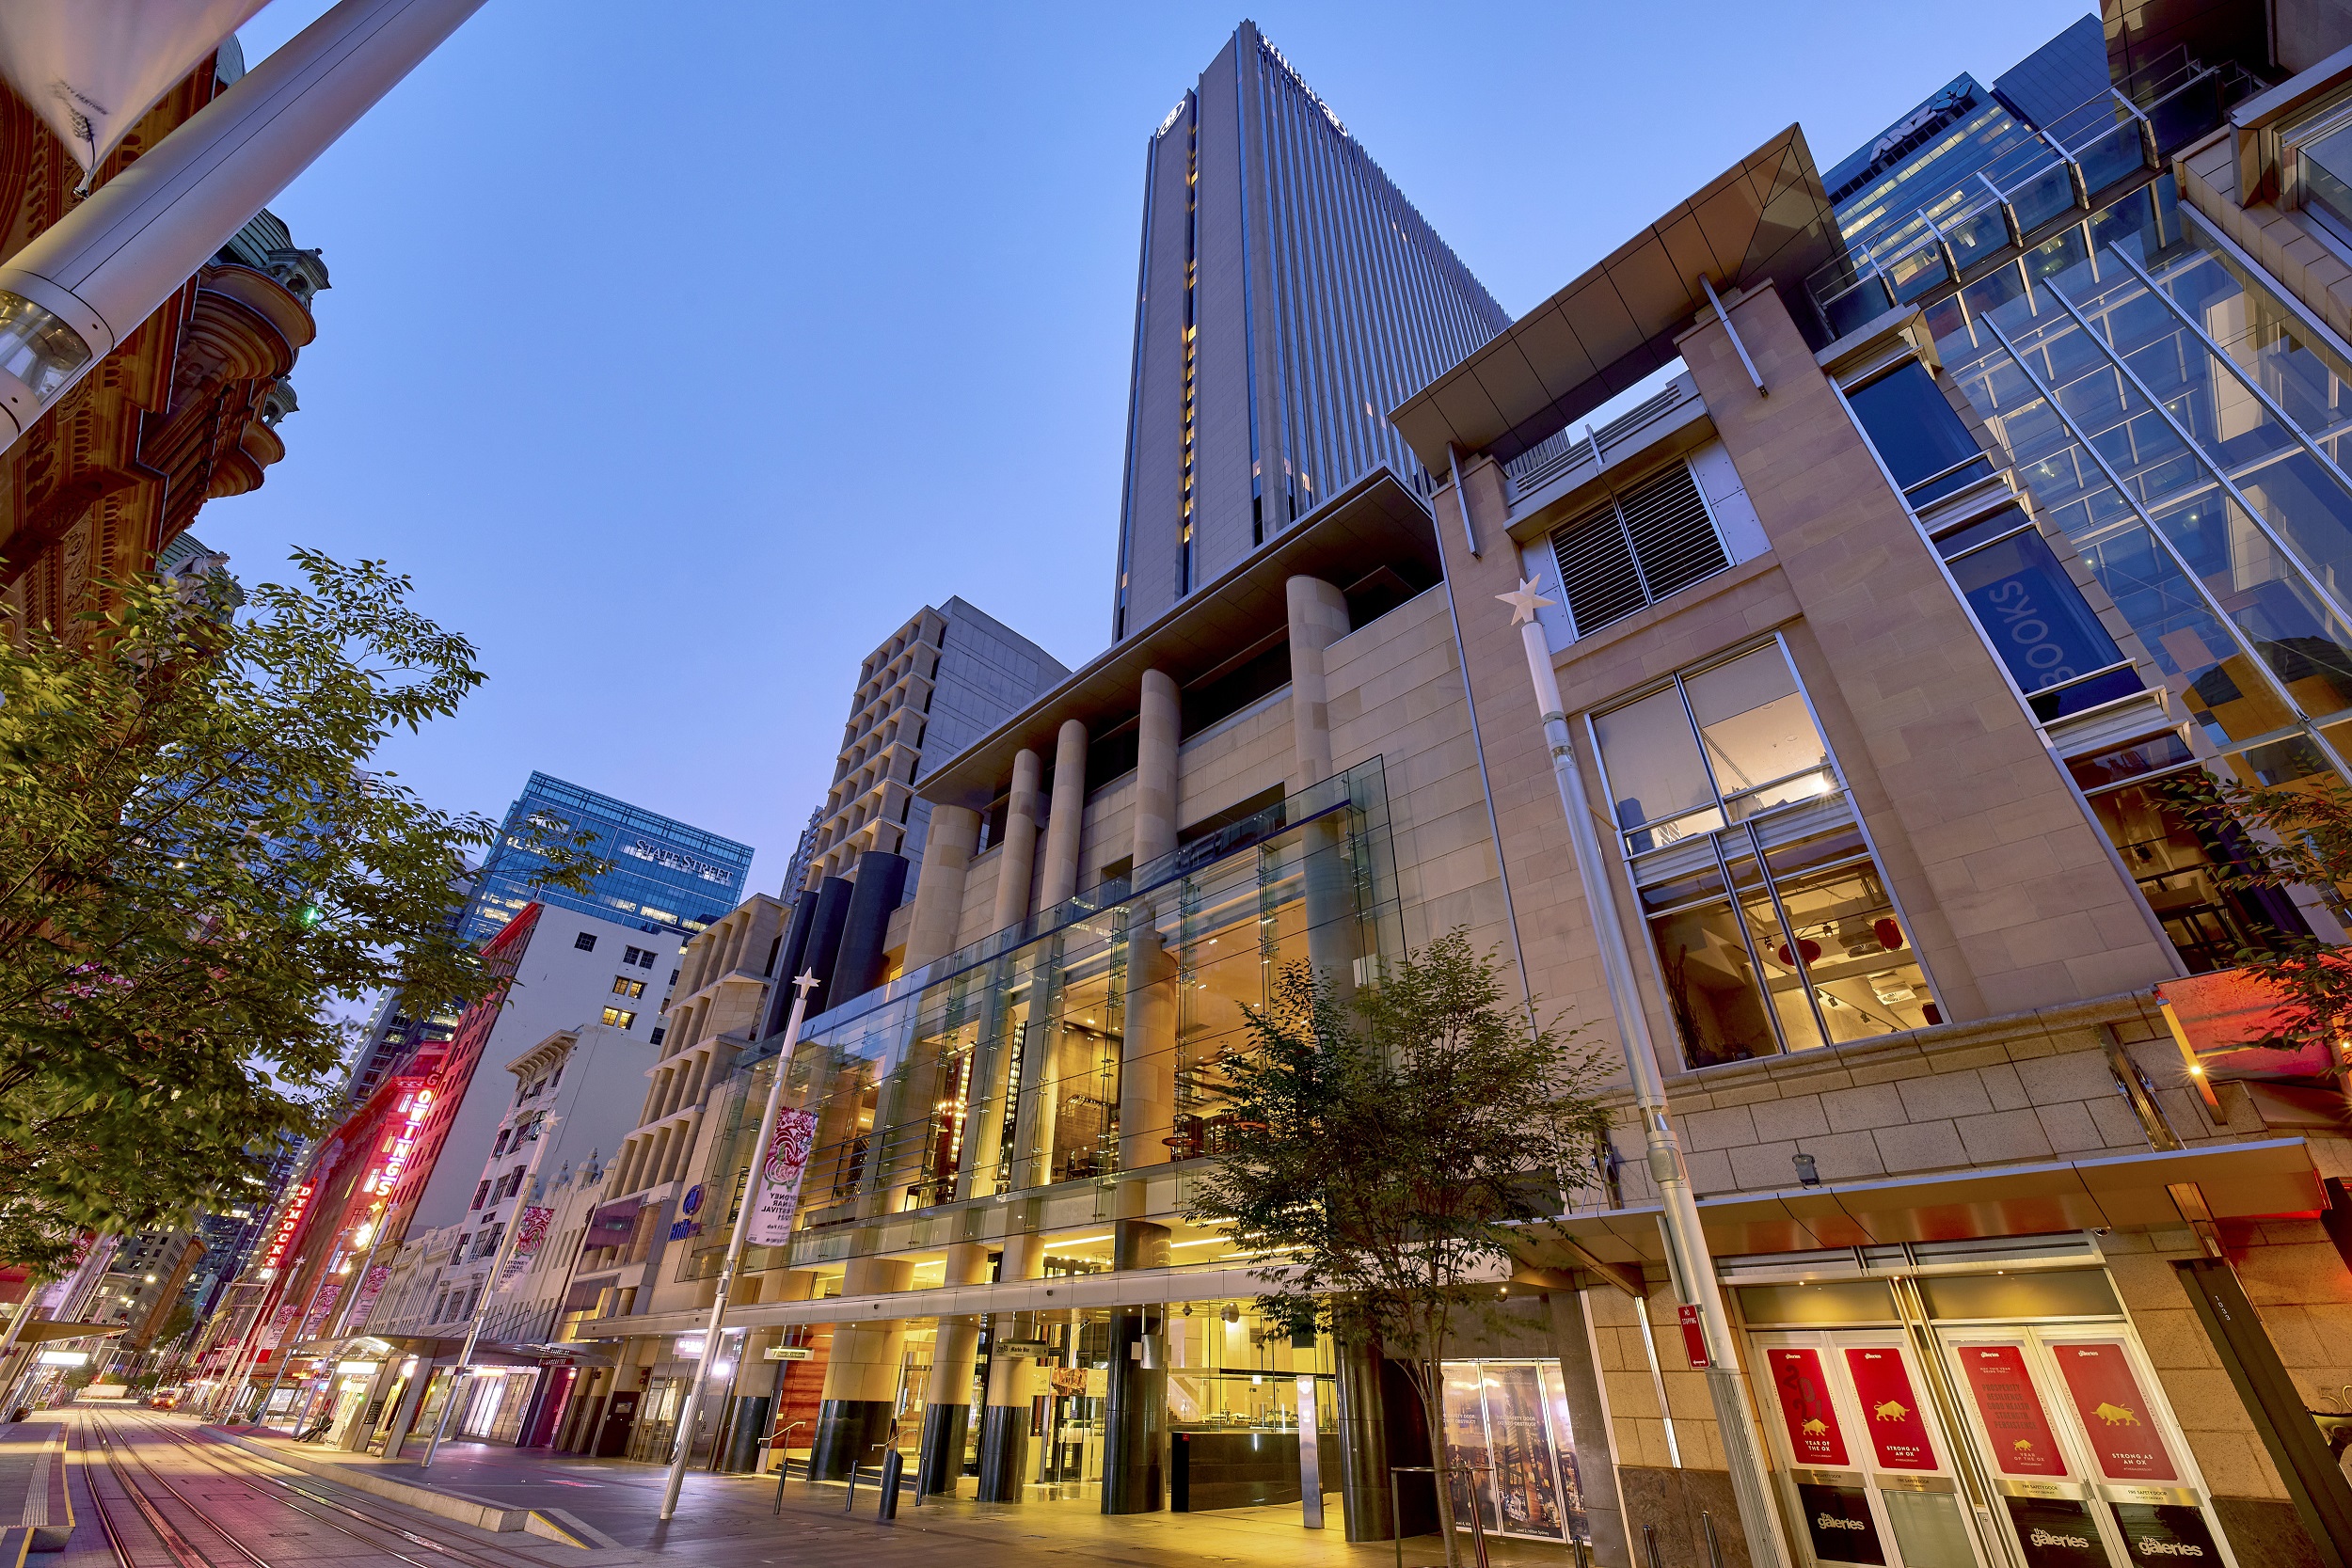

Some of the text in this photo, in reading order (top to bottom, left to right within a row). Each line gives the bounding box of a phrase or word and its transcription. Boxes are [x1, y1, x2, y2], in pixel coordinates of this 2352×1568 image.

[1261, 34, 1317, 103] Hilton
[1869, 104, 1937, 163] ANZ
[1989, 580, 2077, 689] BOOKS
[636, 839, 734, 882] STATE STREET
[375, 1073, 441, 1196] GOWINGS
[267, 1187, 311, 1267] DYMOCKS
[1681, 1317, 1697, 1325] STOPPING
[1817, 1517, 1865, 1530] galeries
[2033, 1528, 2047, 1536] the
[2030, 1533, 2090, 1548] galeries
[2137, 1541, 2203, 1557] galeries
[2141, 1535, 2156, 1544] the
